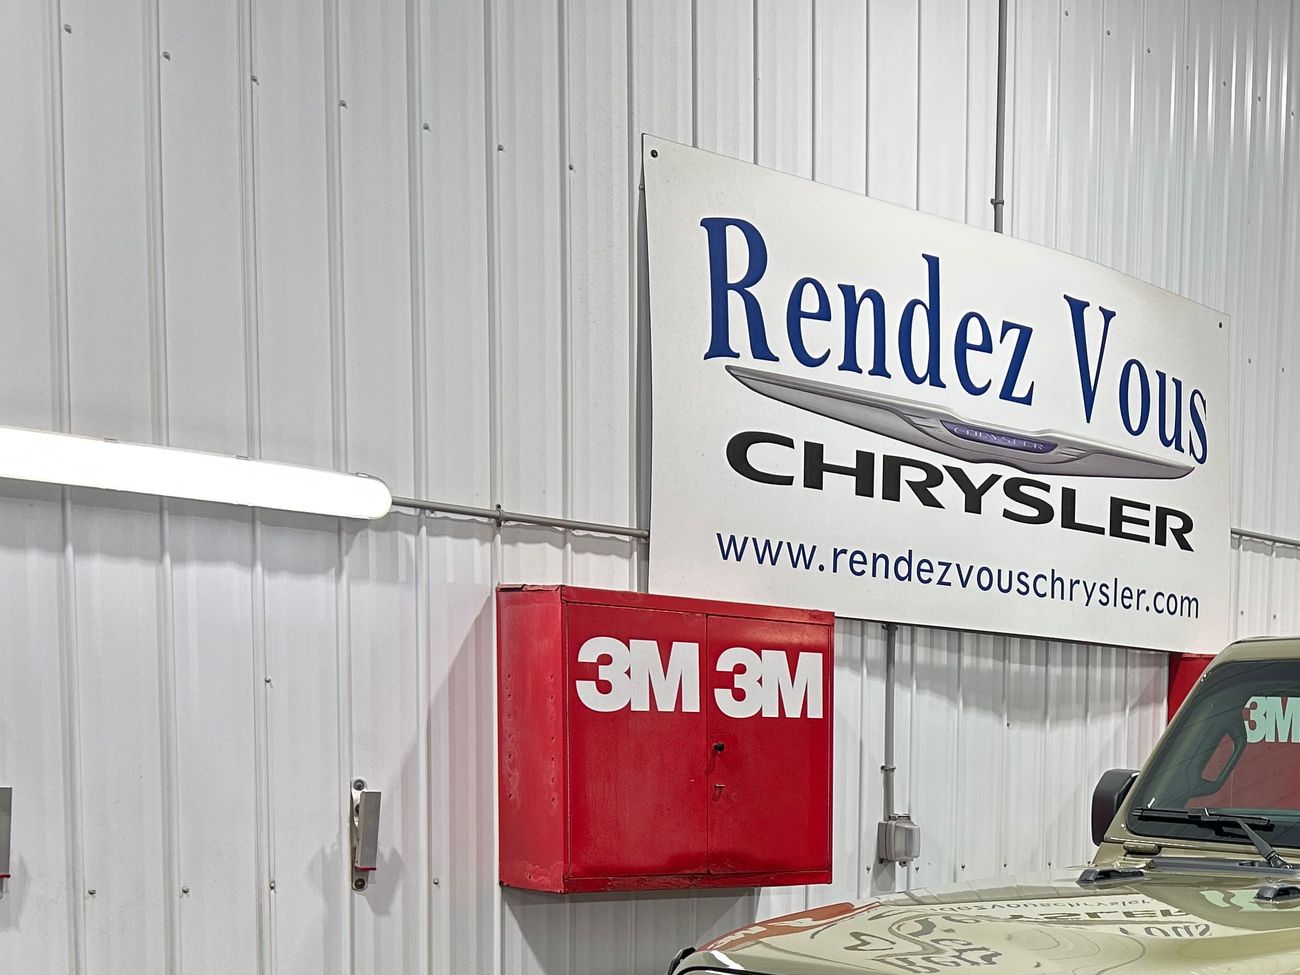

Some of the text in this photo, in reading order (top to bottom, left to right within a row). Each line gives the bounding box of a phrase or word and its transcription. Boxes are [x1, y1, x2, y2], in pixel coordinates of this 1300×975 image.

[700, 217, 1208, 465] Rendez Vous
[953, 426, 1044, 451] CHRYSLER
[726, 431, 1195, 552] CHRYSLER
[716, 532, 1200, 619] www.rendezvouschrysler.com
[575, 636, 824, 719] 3M 3M
